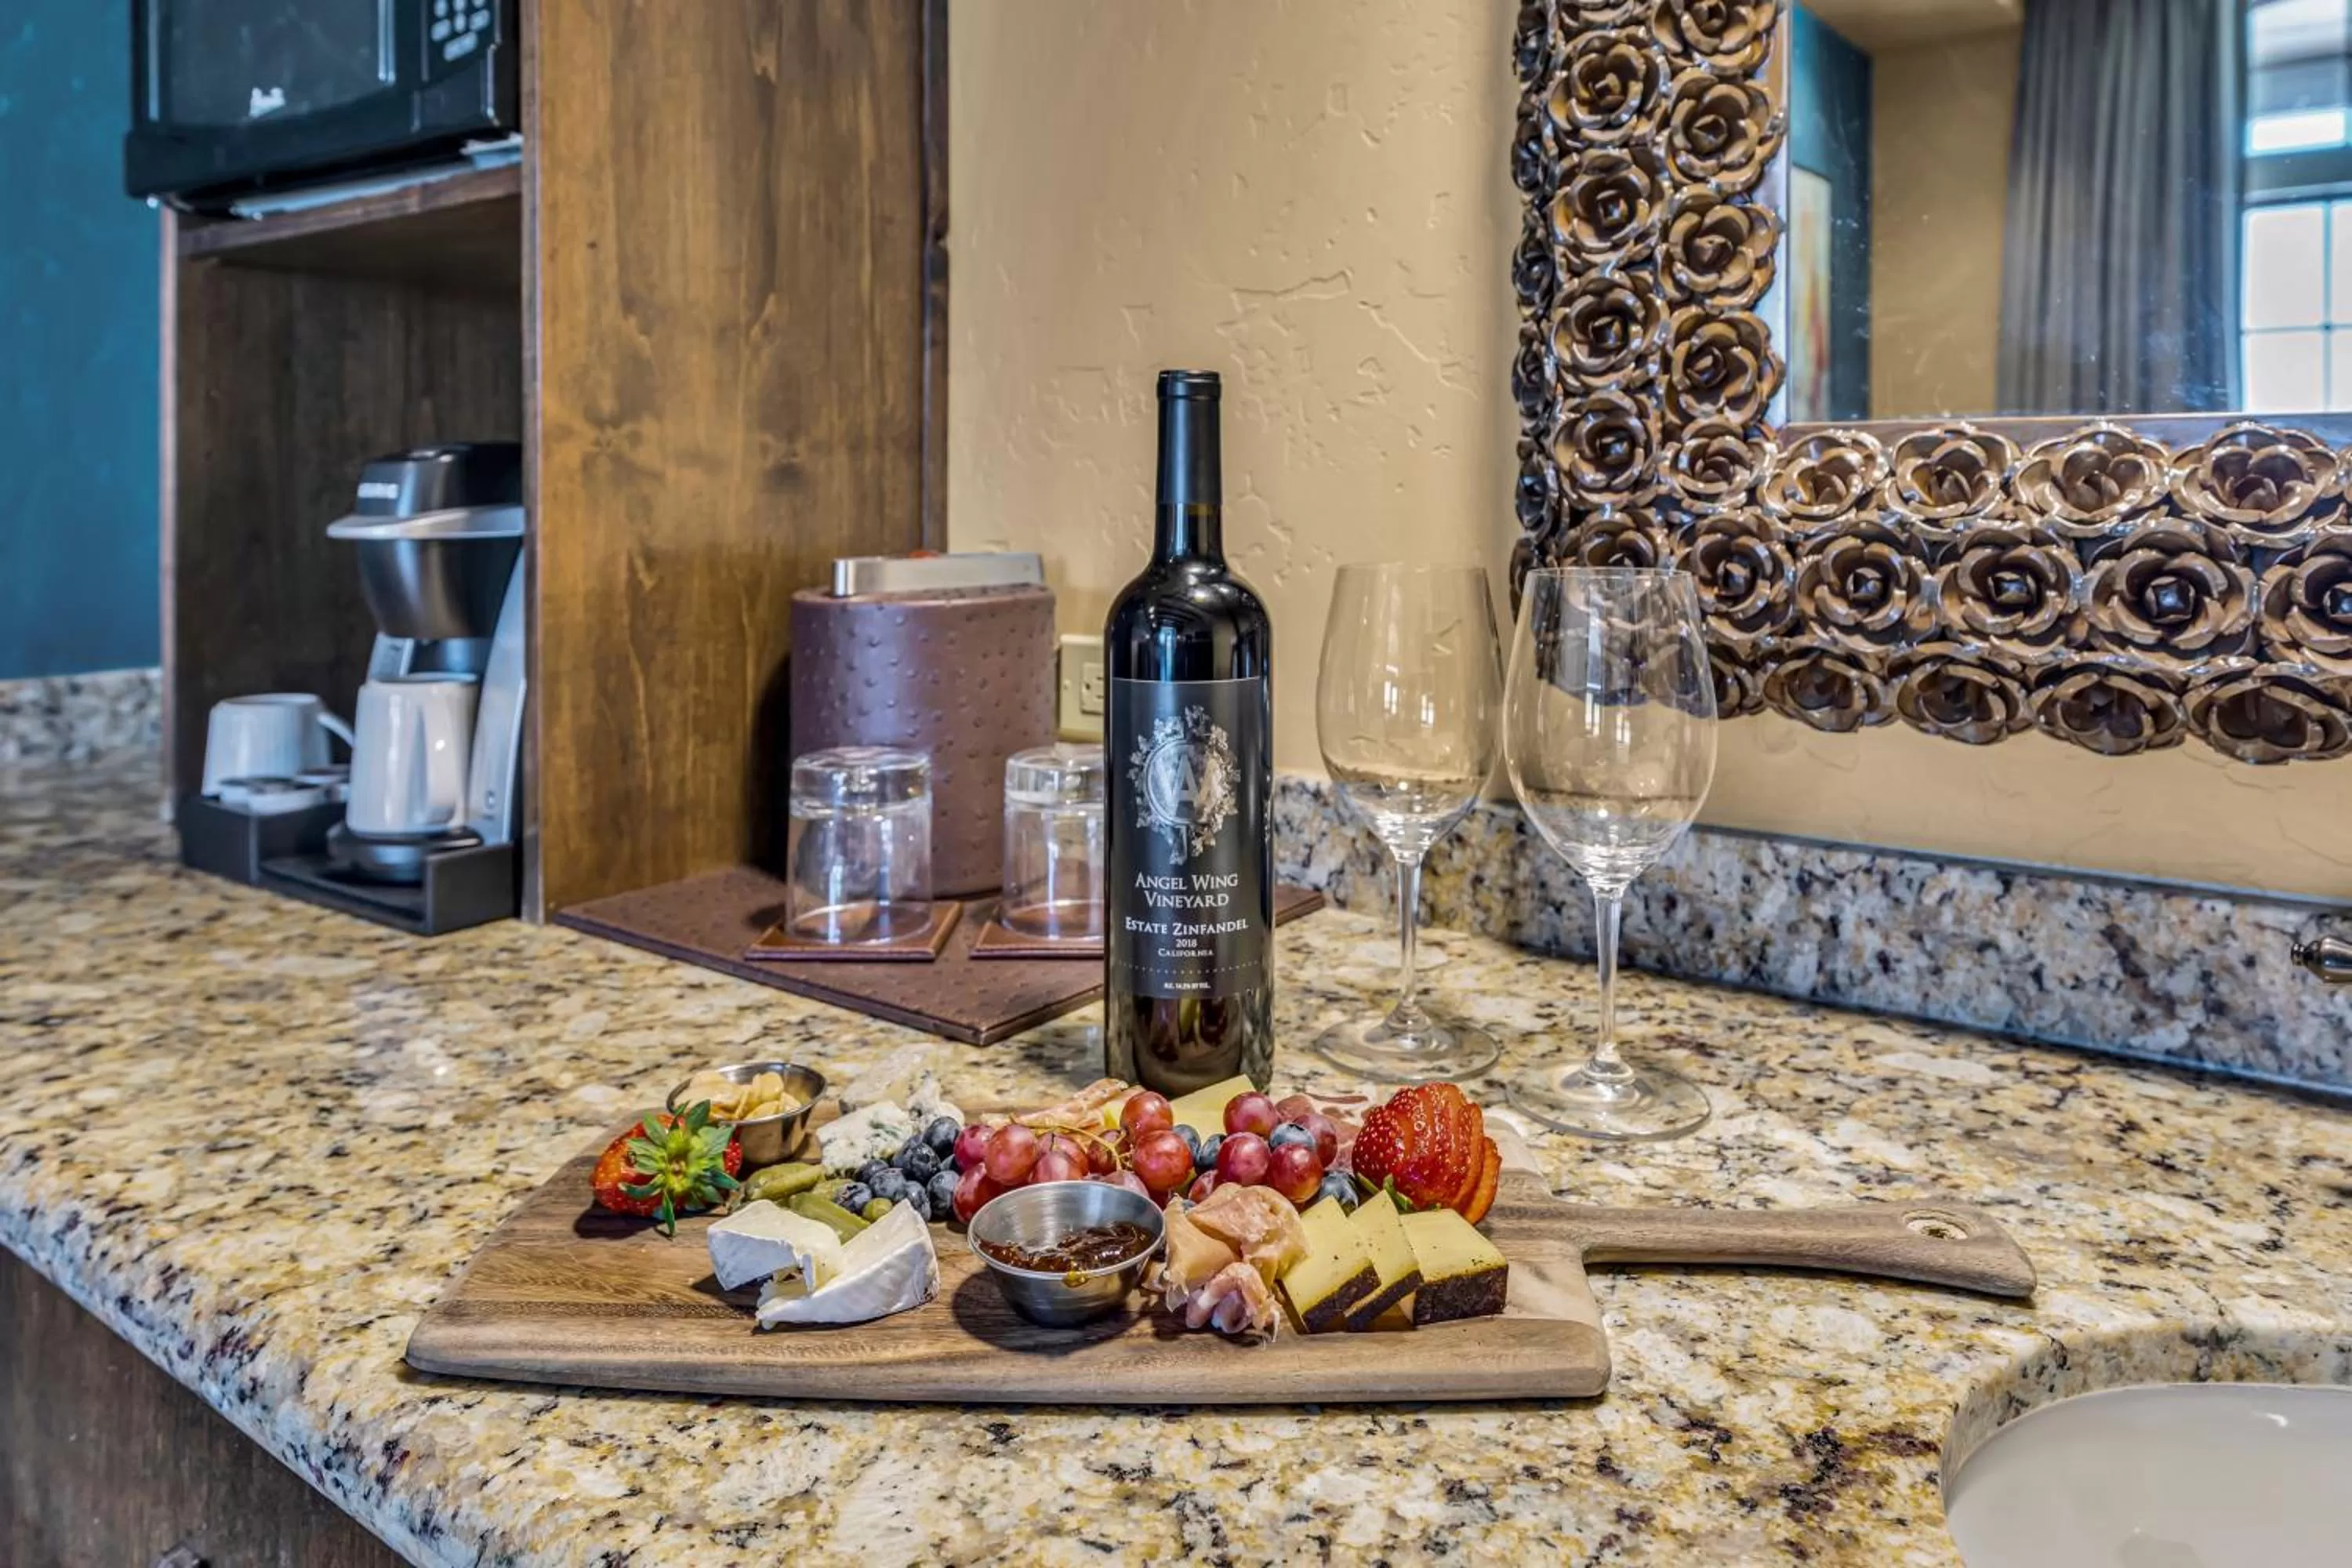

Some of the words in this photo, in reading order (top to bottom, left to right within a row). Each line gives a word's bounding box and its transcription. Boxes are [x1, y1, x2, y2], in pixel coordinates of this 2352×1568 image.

[1135, 872, 1187, 890] ANGEL
[1192, 873, 1239, 891] WING
[1145, 891, 1229, 909] VINEYARD
[1125, 916, 1167, 934] ESTATE
[1173, 918, 1249, 936] ZINFANDEL
[1176, 939, 1197, 948] 2018
